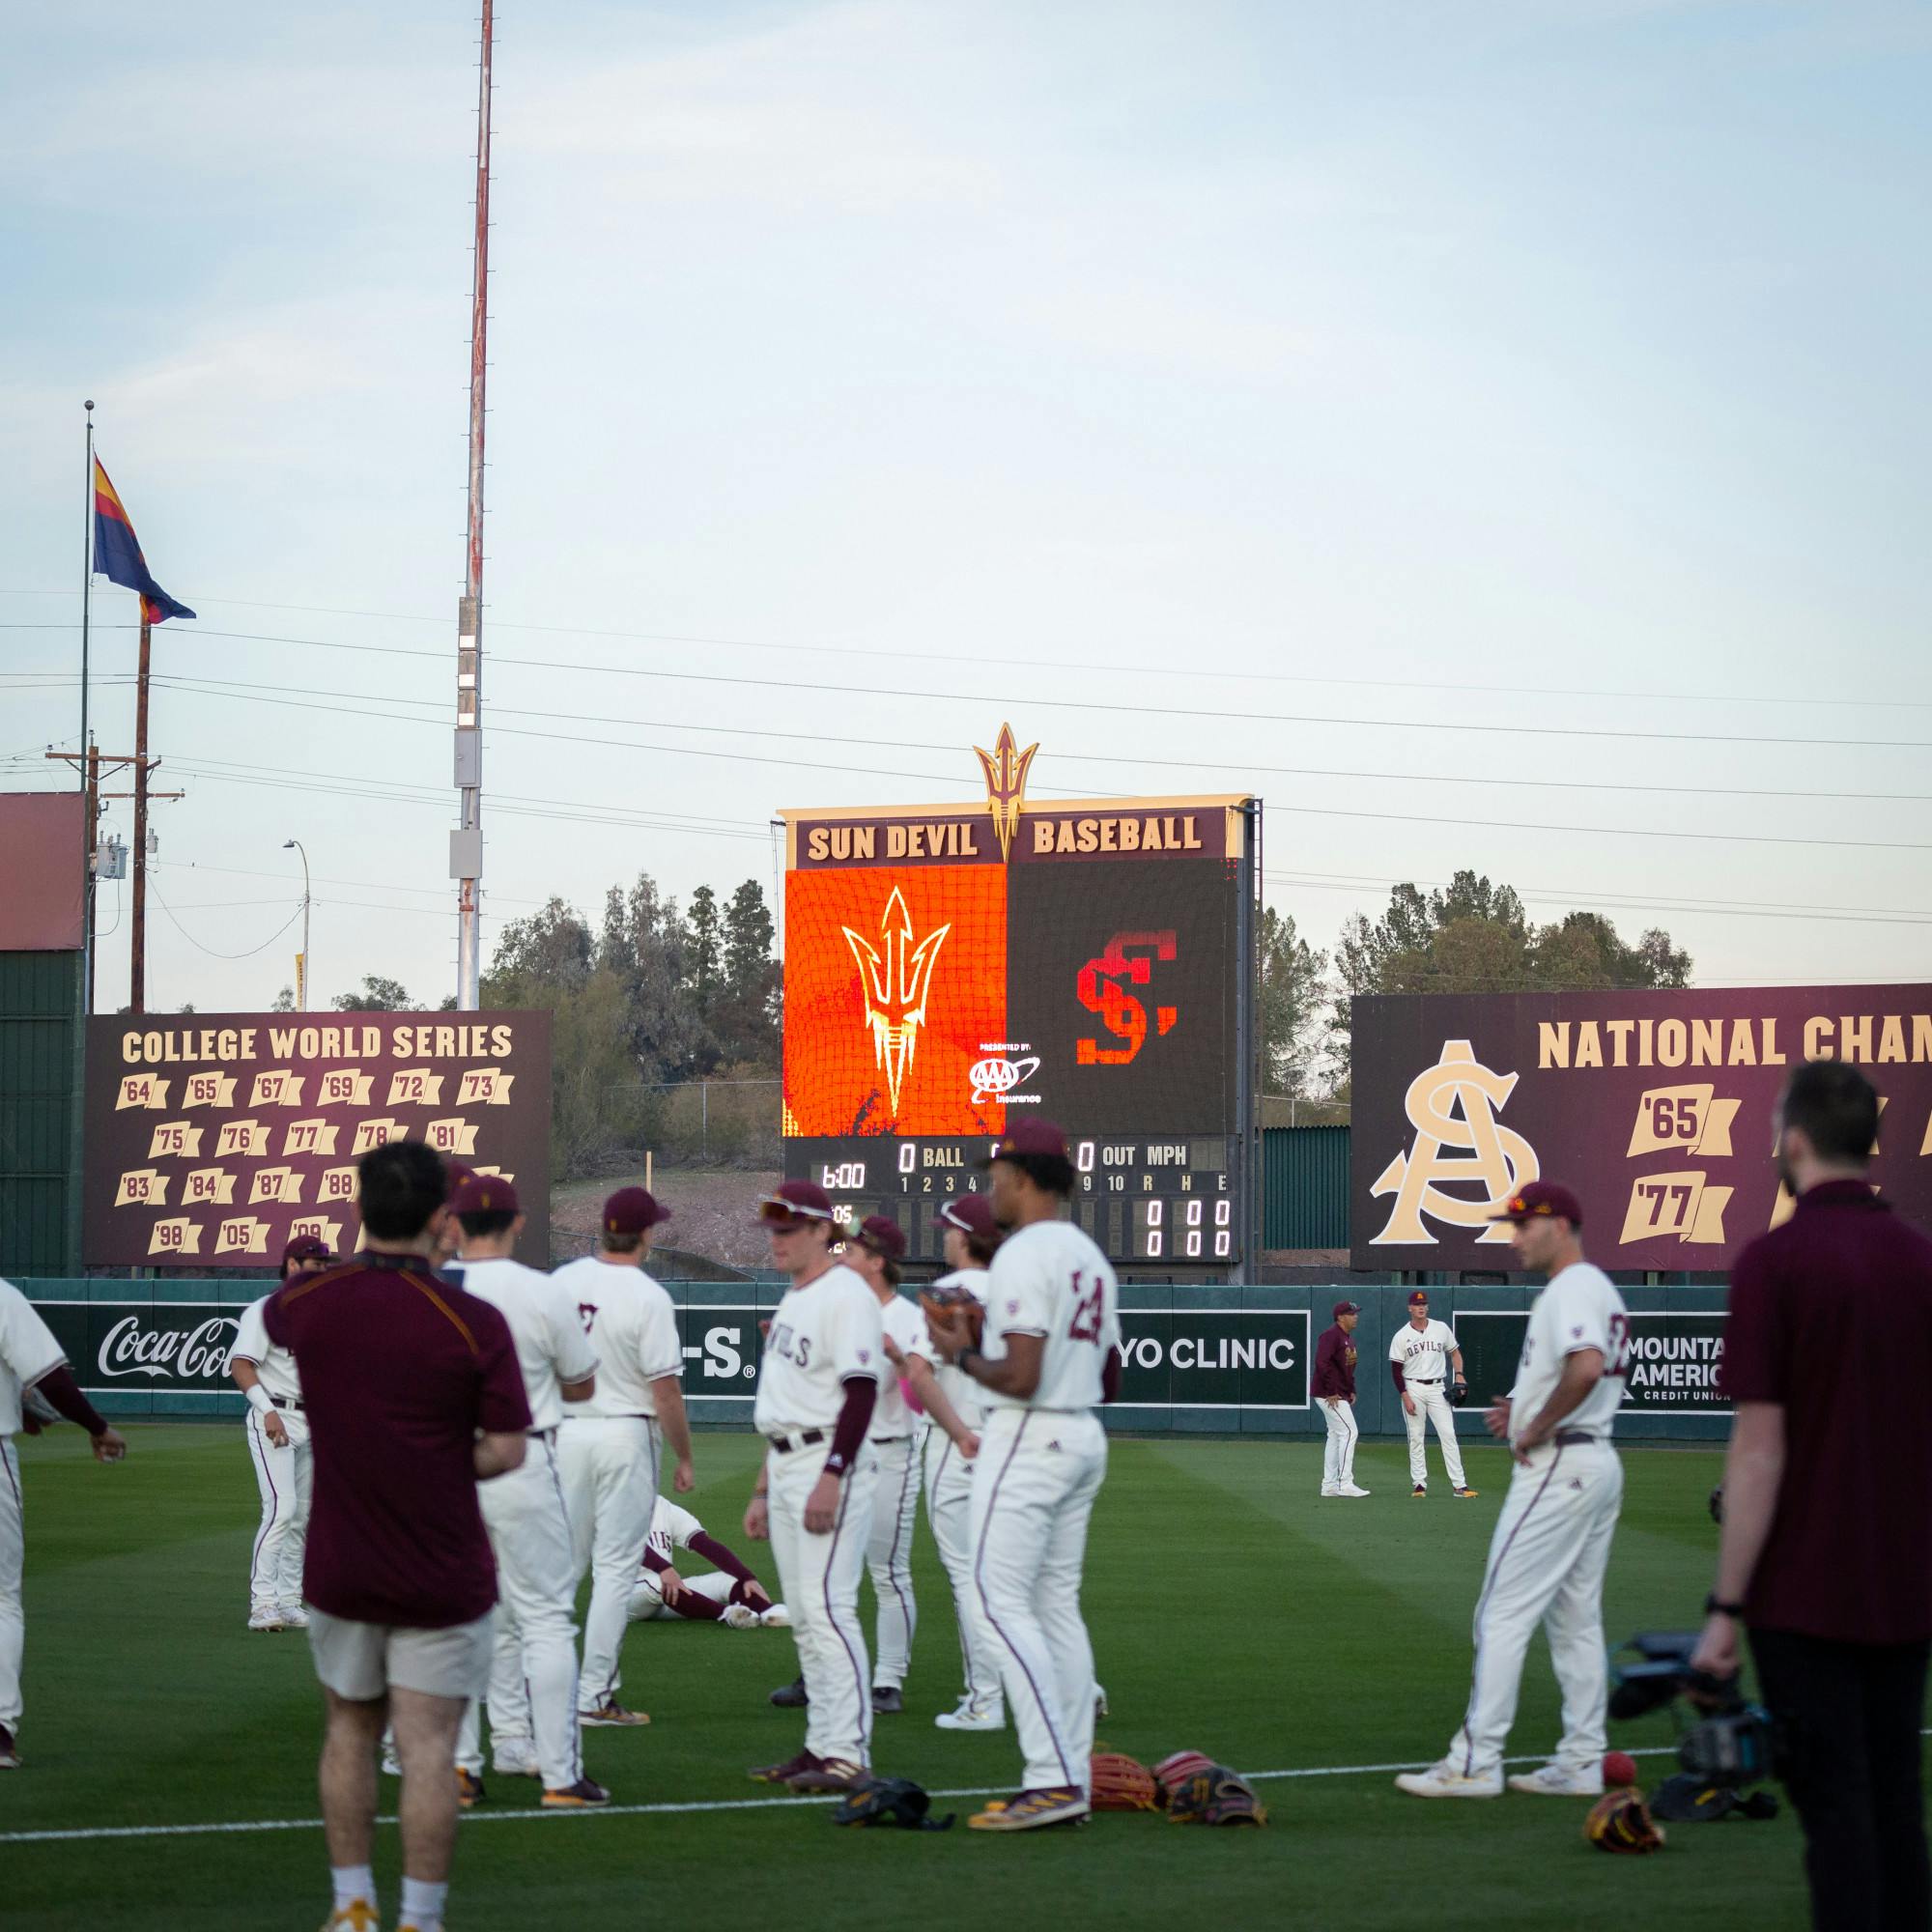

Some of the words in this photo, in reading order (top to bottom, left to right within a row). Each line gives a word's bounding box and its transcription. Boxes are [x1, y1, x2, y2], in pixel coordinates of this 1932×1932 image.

[808, 827, 875, 861] SUN
[886, 823, 979, 858] DEVIL
[1033, 816, 1203, 854] BASEBALL
[123, 1029, 257, 1064] COLLEGE
[269, 1026, 382, 1060] WORLD
[391, 1025, 513, 1059] SERIES
[1537, 1017, 1786, 1069] NATIONAL
[395, 1075, 423, 1097] '72
[465, 1075, 493, 1097] '73
[974, 1061, 1014, 1090] AAA
[124, 1080, 150, 1102] '64
[190, 1079, 217, 1101] '65
[257, 1077, 284, 1099] '67
[326, 1076, 354, 1098] '69
[1644, 1096, 1698, 1140] '65
[156, 1128, 184, 1151] '75
[223, 1127, 250, 1150] '76
[291, 1126, 318, 1148] '77
[359, 1125, 387, 1147] '78
[432, 1125, 456, 1148] '81
[923, 1147, 964, 1168] BALL
[1102, 1147, 1136, 1167] OUT
[1147, 1146, 1187, 1166] MPH
[189, 1176, 216, 1197] '84
[257, 1174, 284, 1196] '87
[326, 1174, 353, 1196] '88
[822, 1163, 866, 1189] 6:00
[900, 1177, 908, 1193] 1
[923, 1177, 932, 1193] 2
[945, 1177, 954, 1192] 3
[968, 1177, 978, 1192] 4
[1083, 1176, 1092, 1191] 9
[1108, 1176, 1124, 1191] 10
[1143, 1175, 1153, 1191] R
[1181, 1175, 1191, 1191] H
[1218, 1175, 1227, 1191] E
[124, 1177, 149, 1199] '83
[1147, 1200, 1163, 1227] 0
[1186, 1200, 1202, 1227] 0
[1214, 1200, 1231, 1227] 0
[1637, 1183, 1693, 1227] '77
[156, 1225, 183, 1247] '98
[223, 1224, 250, 1246] '05
[1147, 1230, 1162, 1257] 0
[1186, 1230, 1202, 1257] 0
[1214, 1230, 1231, 1257] 0
[1169, 1337, 1295, 1371] CLINIC
[1406, 1340, 1442, 1357] DEVILS
[1643, 1391, 1690, 1401] CREDIT
